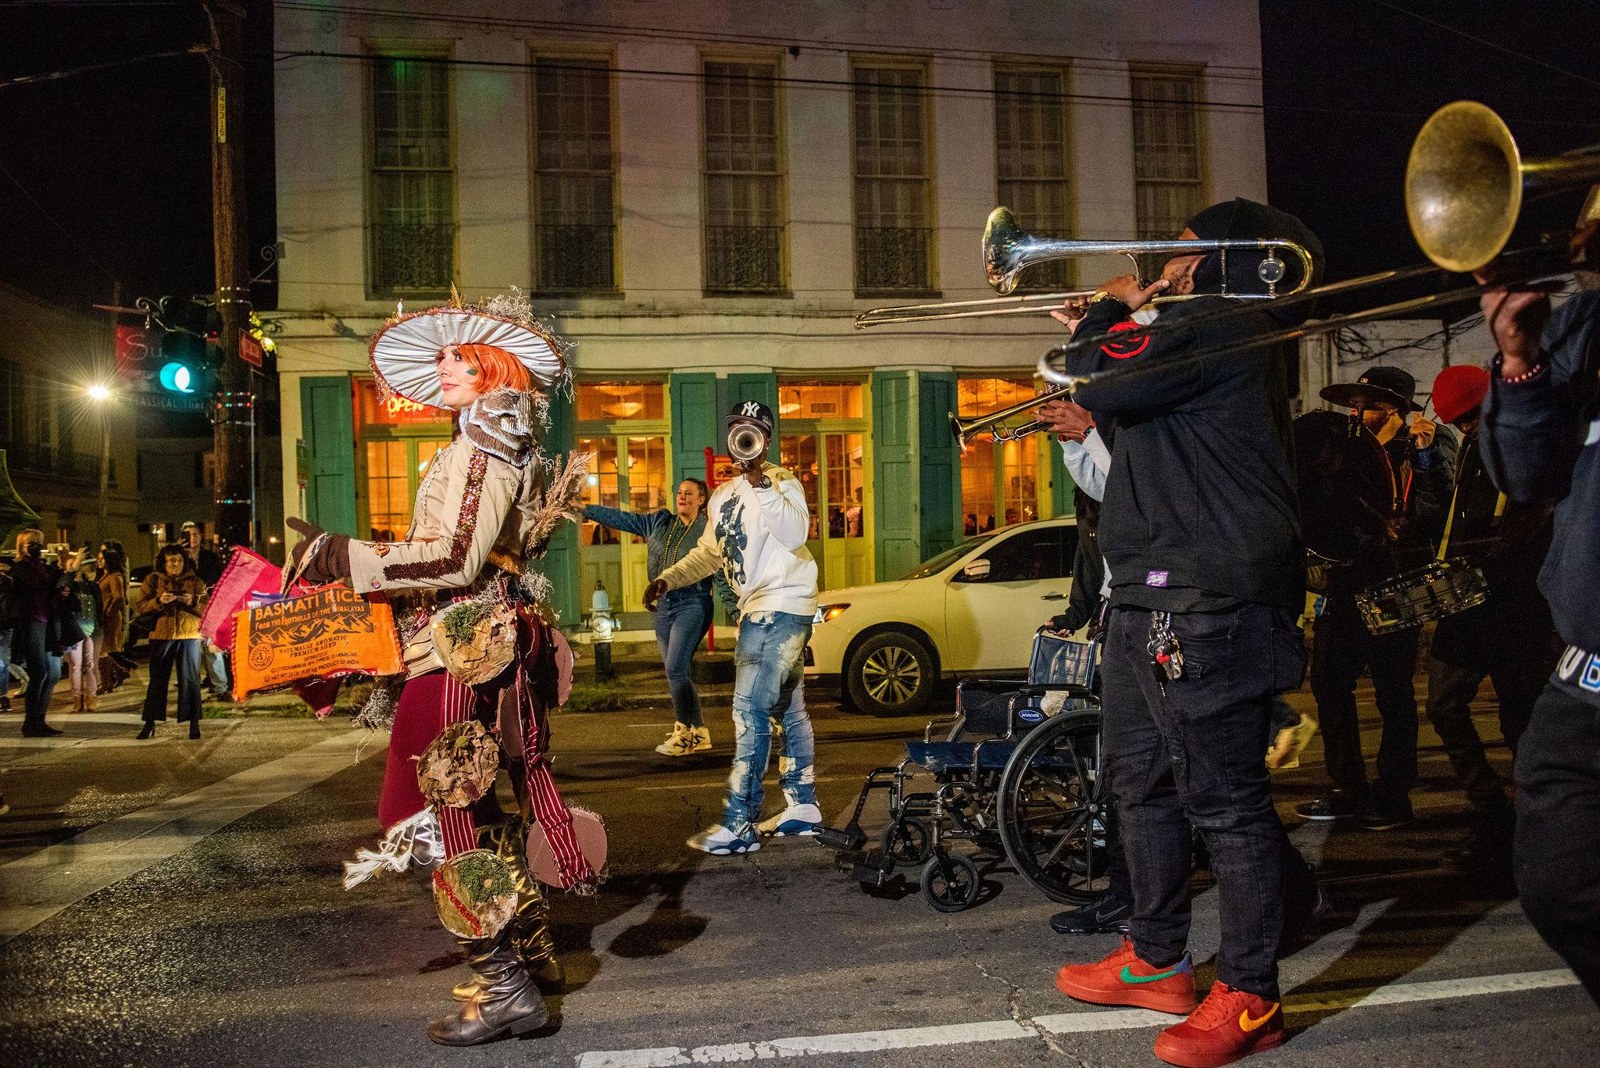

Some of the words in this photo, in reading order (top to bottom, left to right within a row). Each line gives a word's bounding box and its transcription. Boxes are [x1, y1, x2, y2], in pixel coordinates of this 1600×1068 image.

[740, 400, 760, 418] NY
[255, 595, 319, 620] BASMATI
[324, 589, 365, 604] RICE
[320, 607, 331, 616] THE
[315, 635, 347, 648] AROMATIC
[320, 641, 337, 650] AGED
